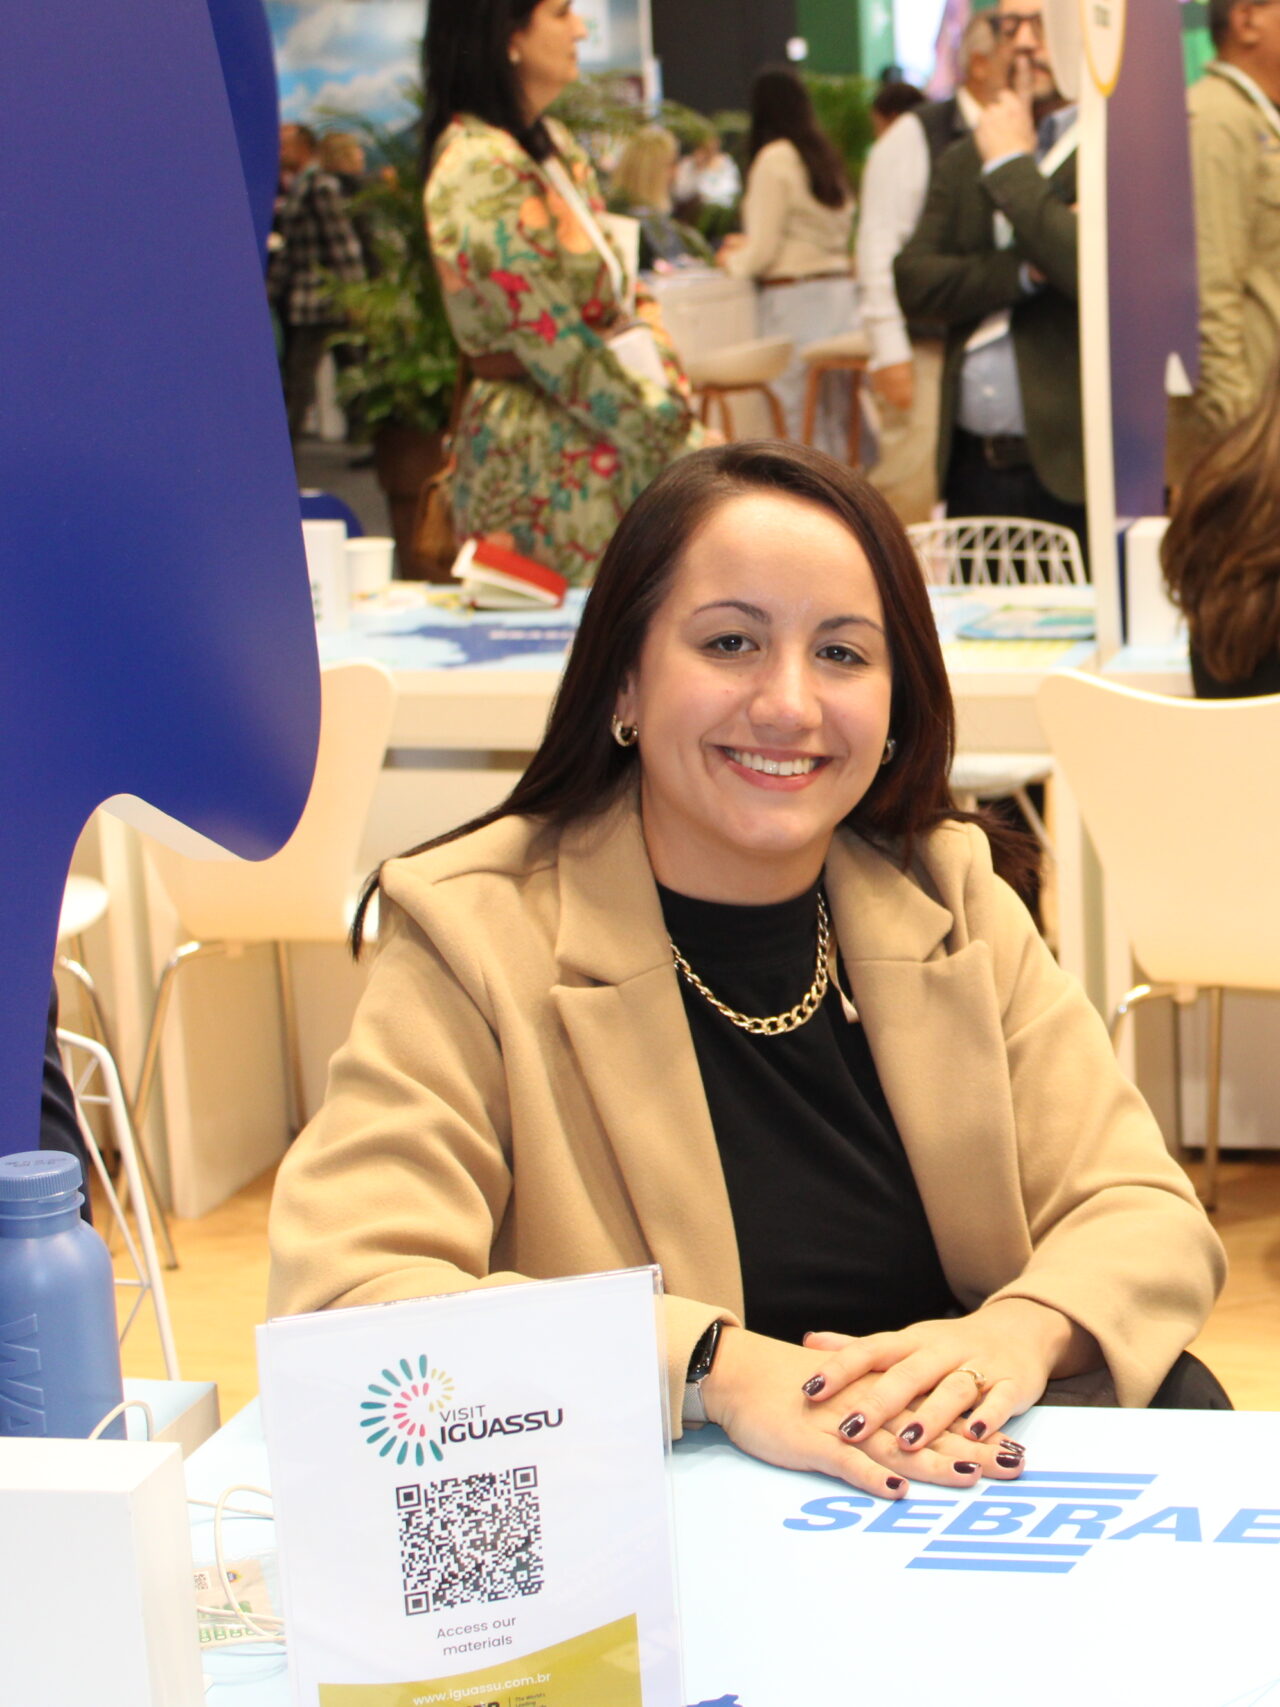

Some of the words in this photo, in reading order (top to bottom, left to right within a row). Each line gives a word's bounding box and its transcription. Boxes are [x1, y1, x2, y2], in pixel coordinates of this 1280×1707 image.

[440, 1404, 486, 1423] VISIT
[440, 1408, 563, 1445] IGUASSU
[437, 1621, 488, 1639] Access
[492, 1616, 516, 1630] our
[443, 1635, 513, 1656] materials
[413, 1672, 551, 1706] www.iguassu.com.br
